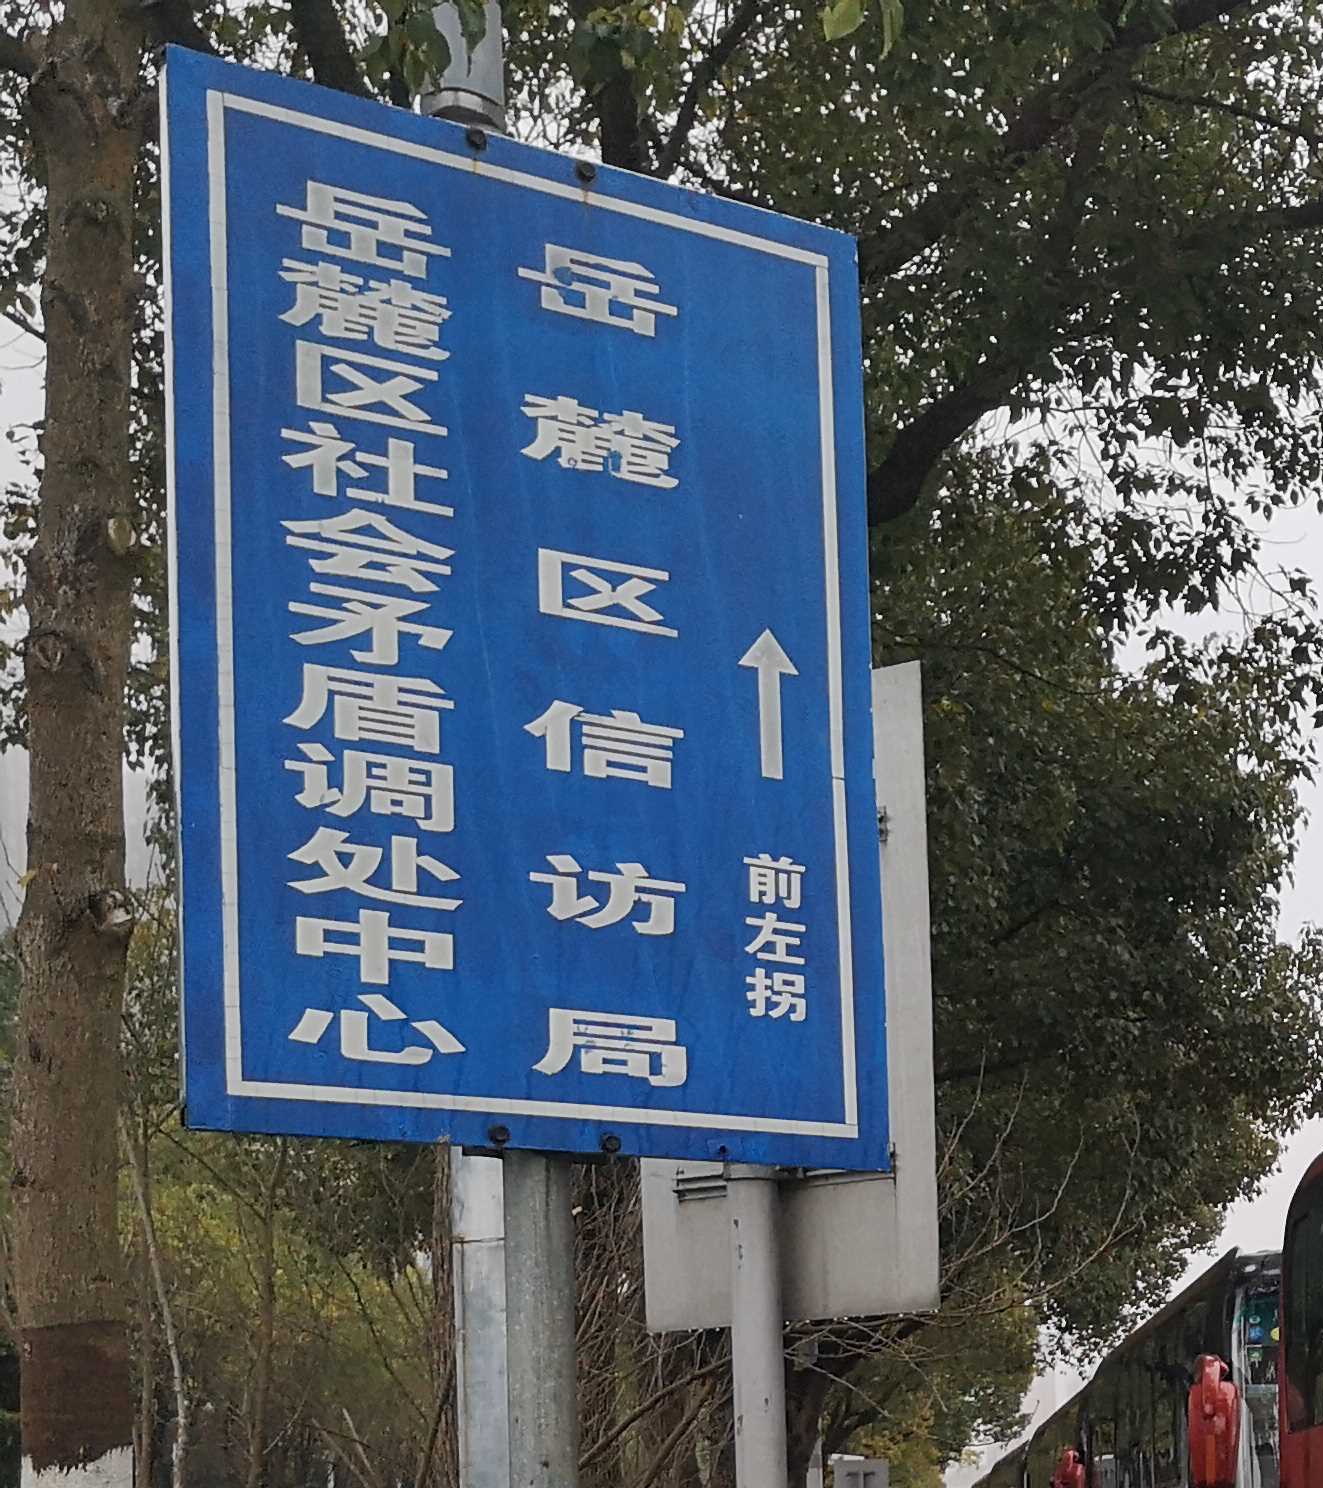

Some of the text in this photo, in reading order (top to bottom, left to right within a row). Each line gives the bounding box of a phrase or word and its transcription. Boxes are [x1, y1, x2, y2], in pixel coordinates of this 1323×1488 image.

[276, 179, 467, 1066] 岳麓区社会矛盾调处中心
[517, 242, 689, 1087] 岳麓区信访局
[741, 852, 808, 1022] 前左拐
